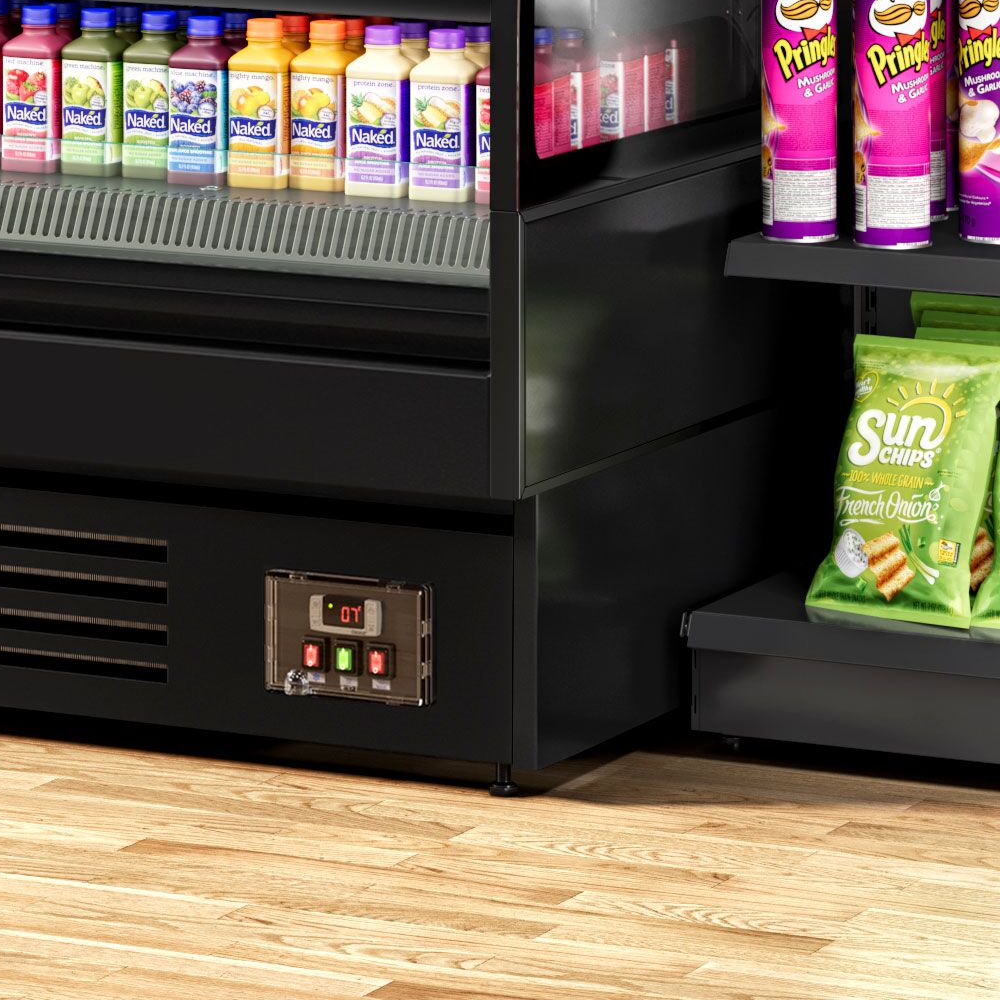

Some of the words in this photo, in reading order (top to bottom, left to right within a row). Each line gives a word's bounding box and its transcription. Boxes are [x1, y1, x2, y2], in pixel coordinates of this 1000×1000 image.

[964, 71, 1000, 87] MUSHROO
[804, 88, 813, 98] &
[968, 88, 976, 97] &
[977, 82, 1000, 95] GARLI
[898, 94, 907, 103] &
[848, 409, 948, 466] Sun
[878, 447, 936, 468] CHIPS
[850, 470, 869, 482] 100%
[872, 473, 898, 486] WHOLE
[898, 474, 924, 488] GRAIN
[836, 486, 885, 520] French
[886, 490, 933, 519] Onion
